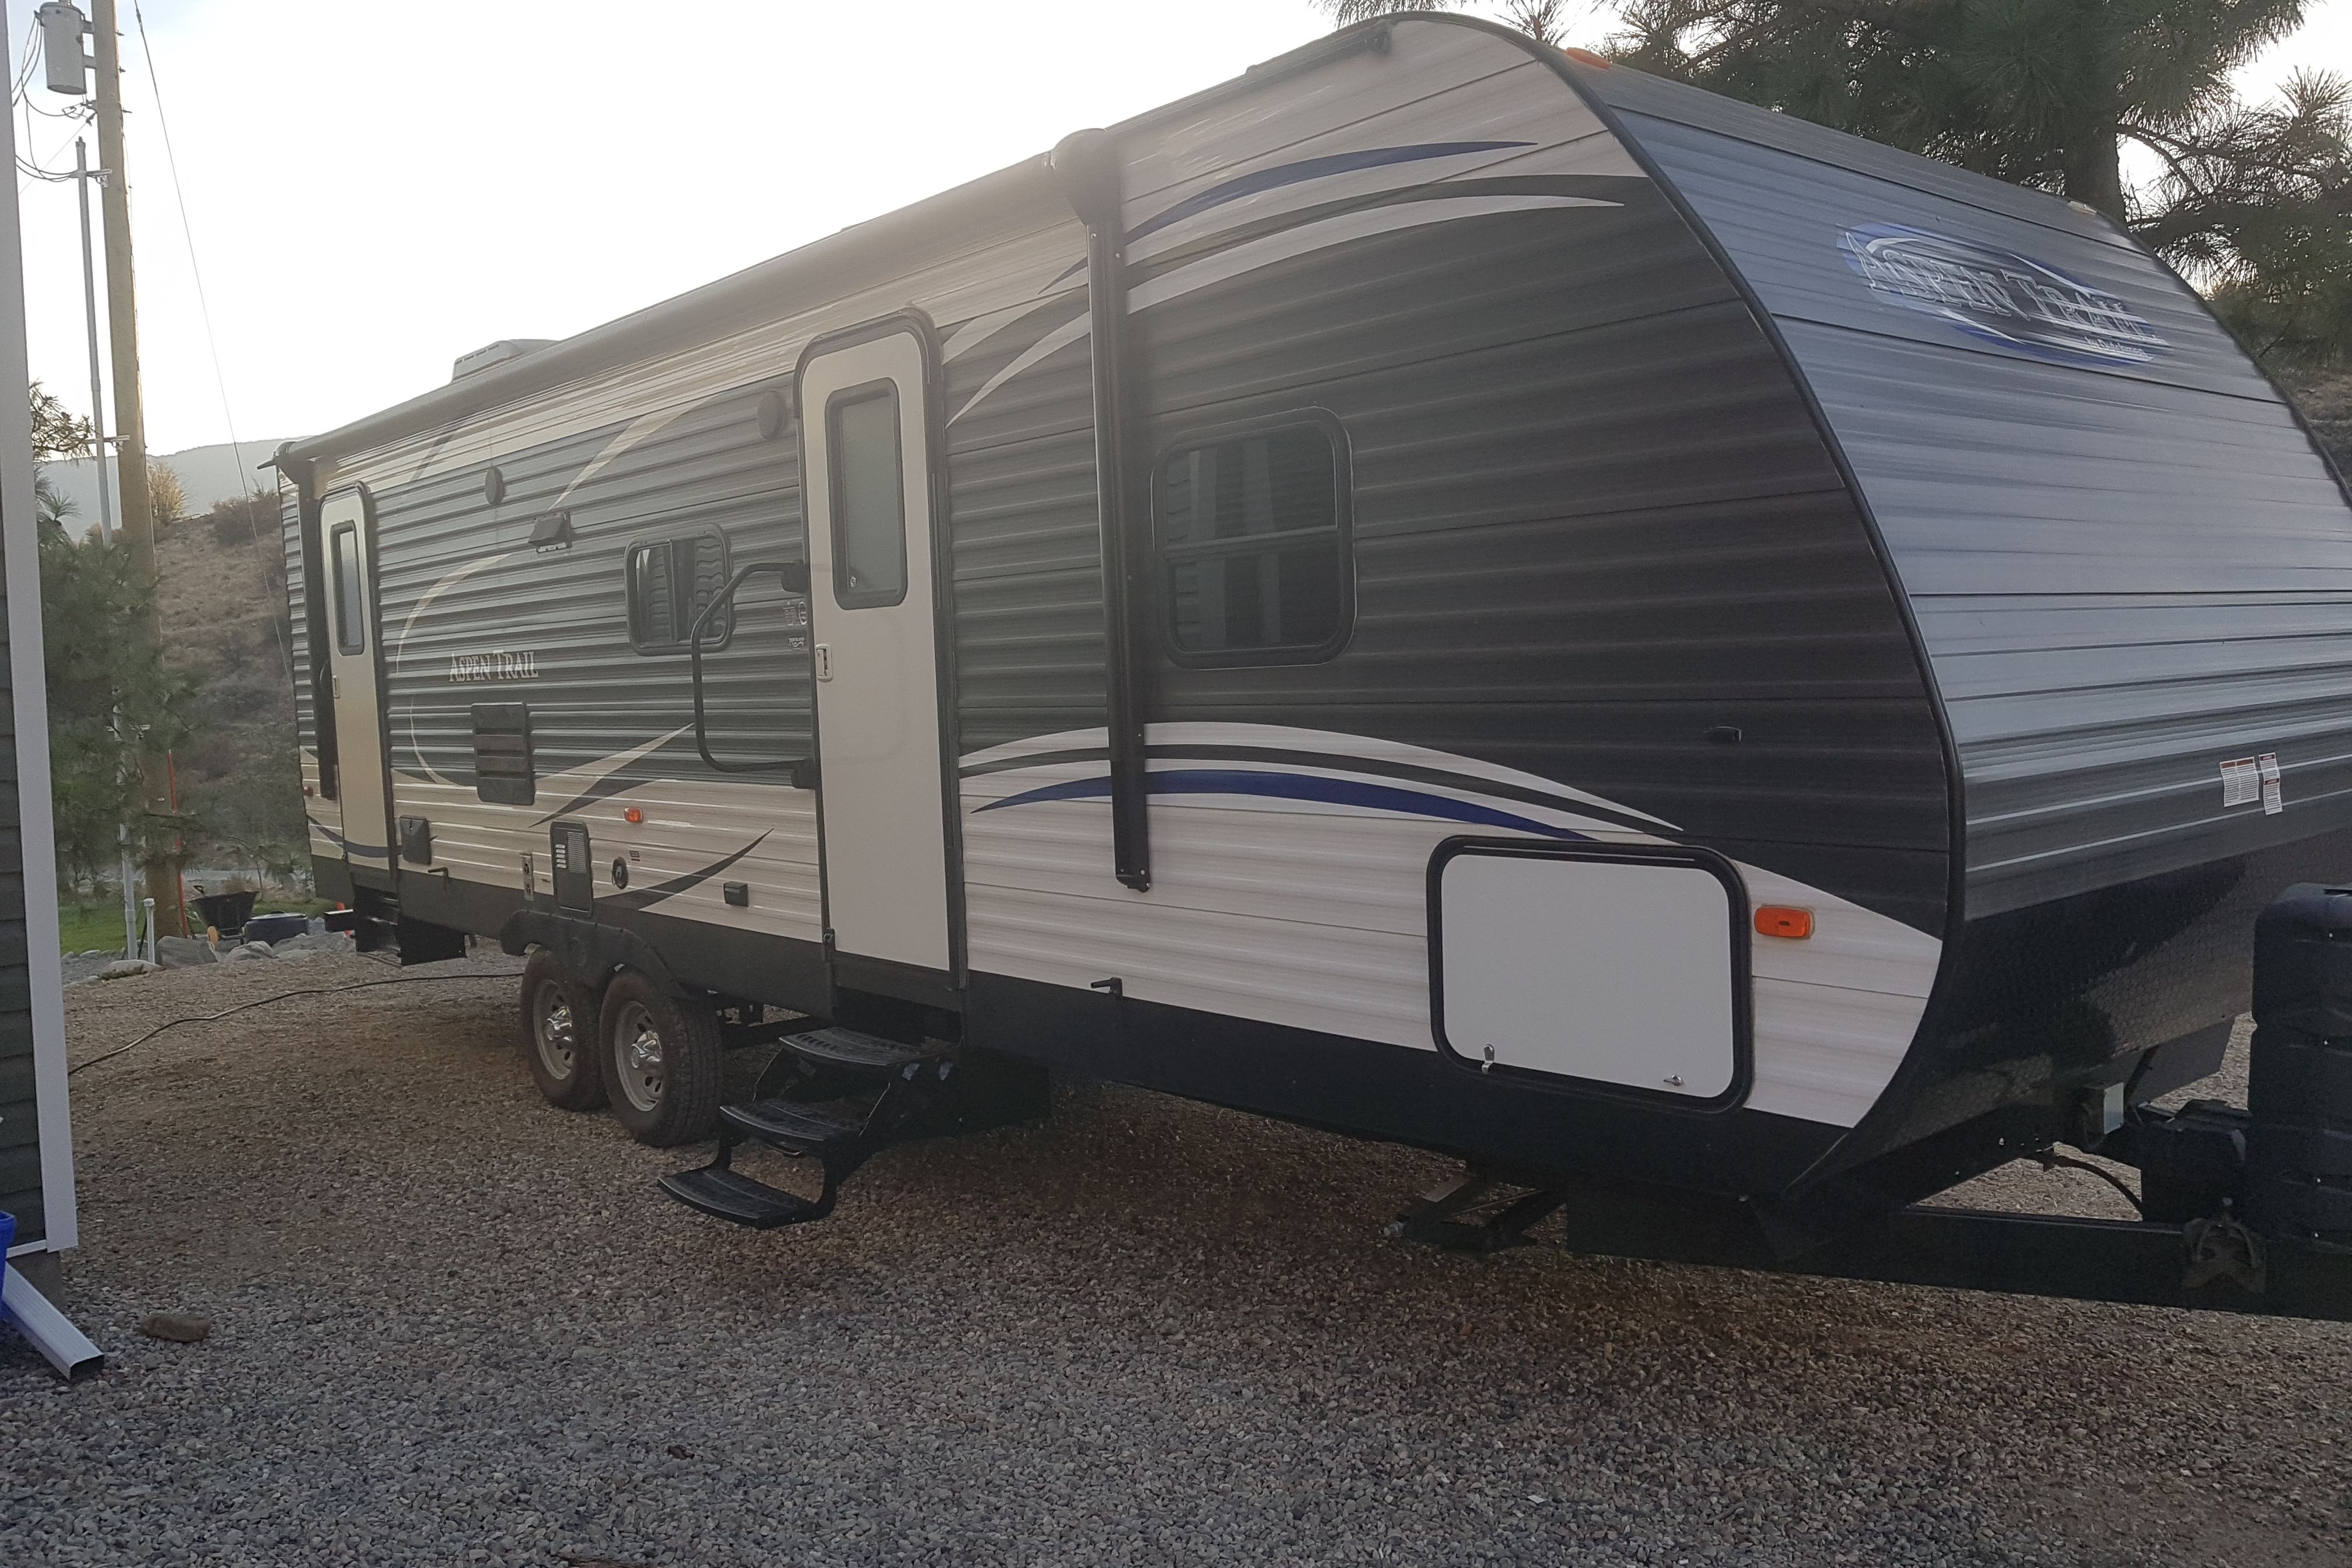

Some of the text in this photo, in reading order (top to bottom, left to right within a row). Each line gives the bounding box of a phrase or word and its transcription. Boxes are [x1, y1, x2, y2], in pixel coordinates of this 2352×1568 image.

[1845, 232, 2031, 321] ASPEN
[449, 649, 539, 682] ASPEN TRAIL
